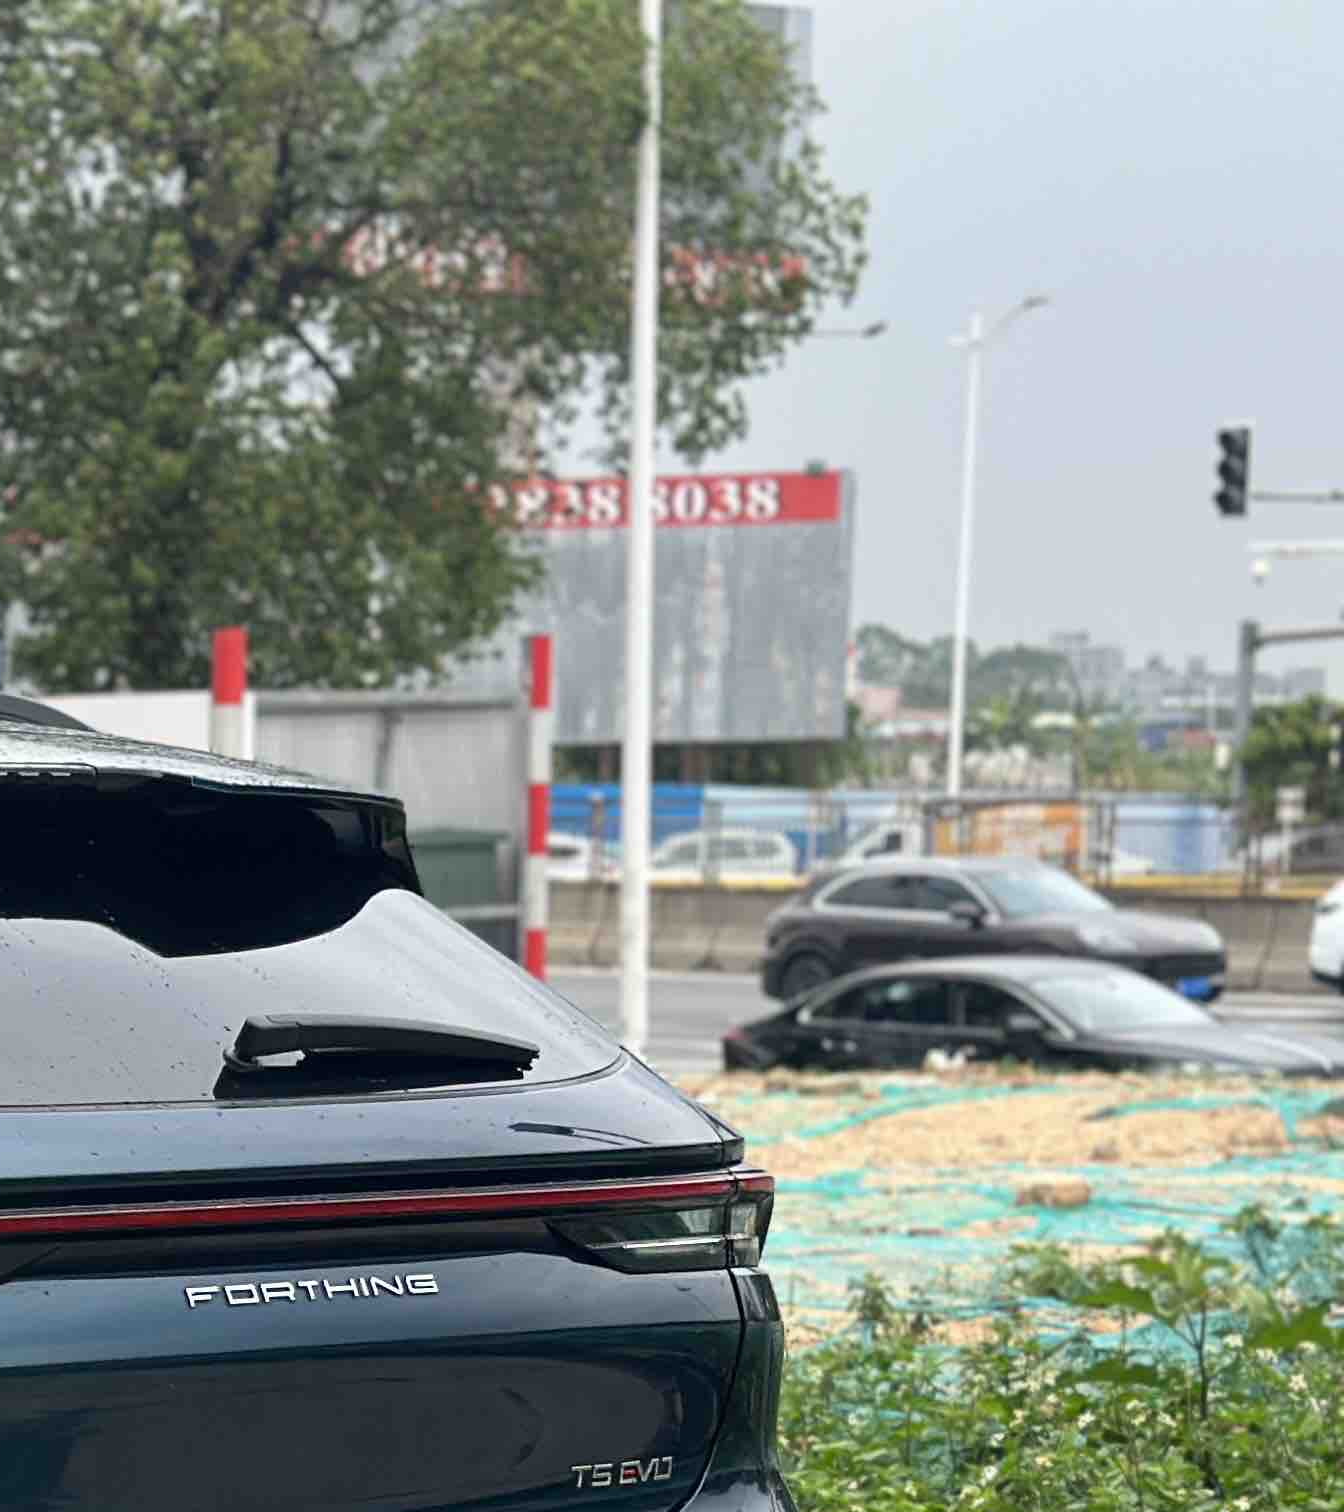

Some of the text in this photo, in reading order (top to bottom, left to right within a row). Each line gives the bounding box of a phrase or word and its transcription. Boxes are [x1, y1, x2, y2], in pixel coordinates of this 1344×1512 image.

[185, 1273, 440, 1308] FORTHING
[571, 1456, 673, 1488] T5 EVO
